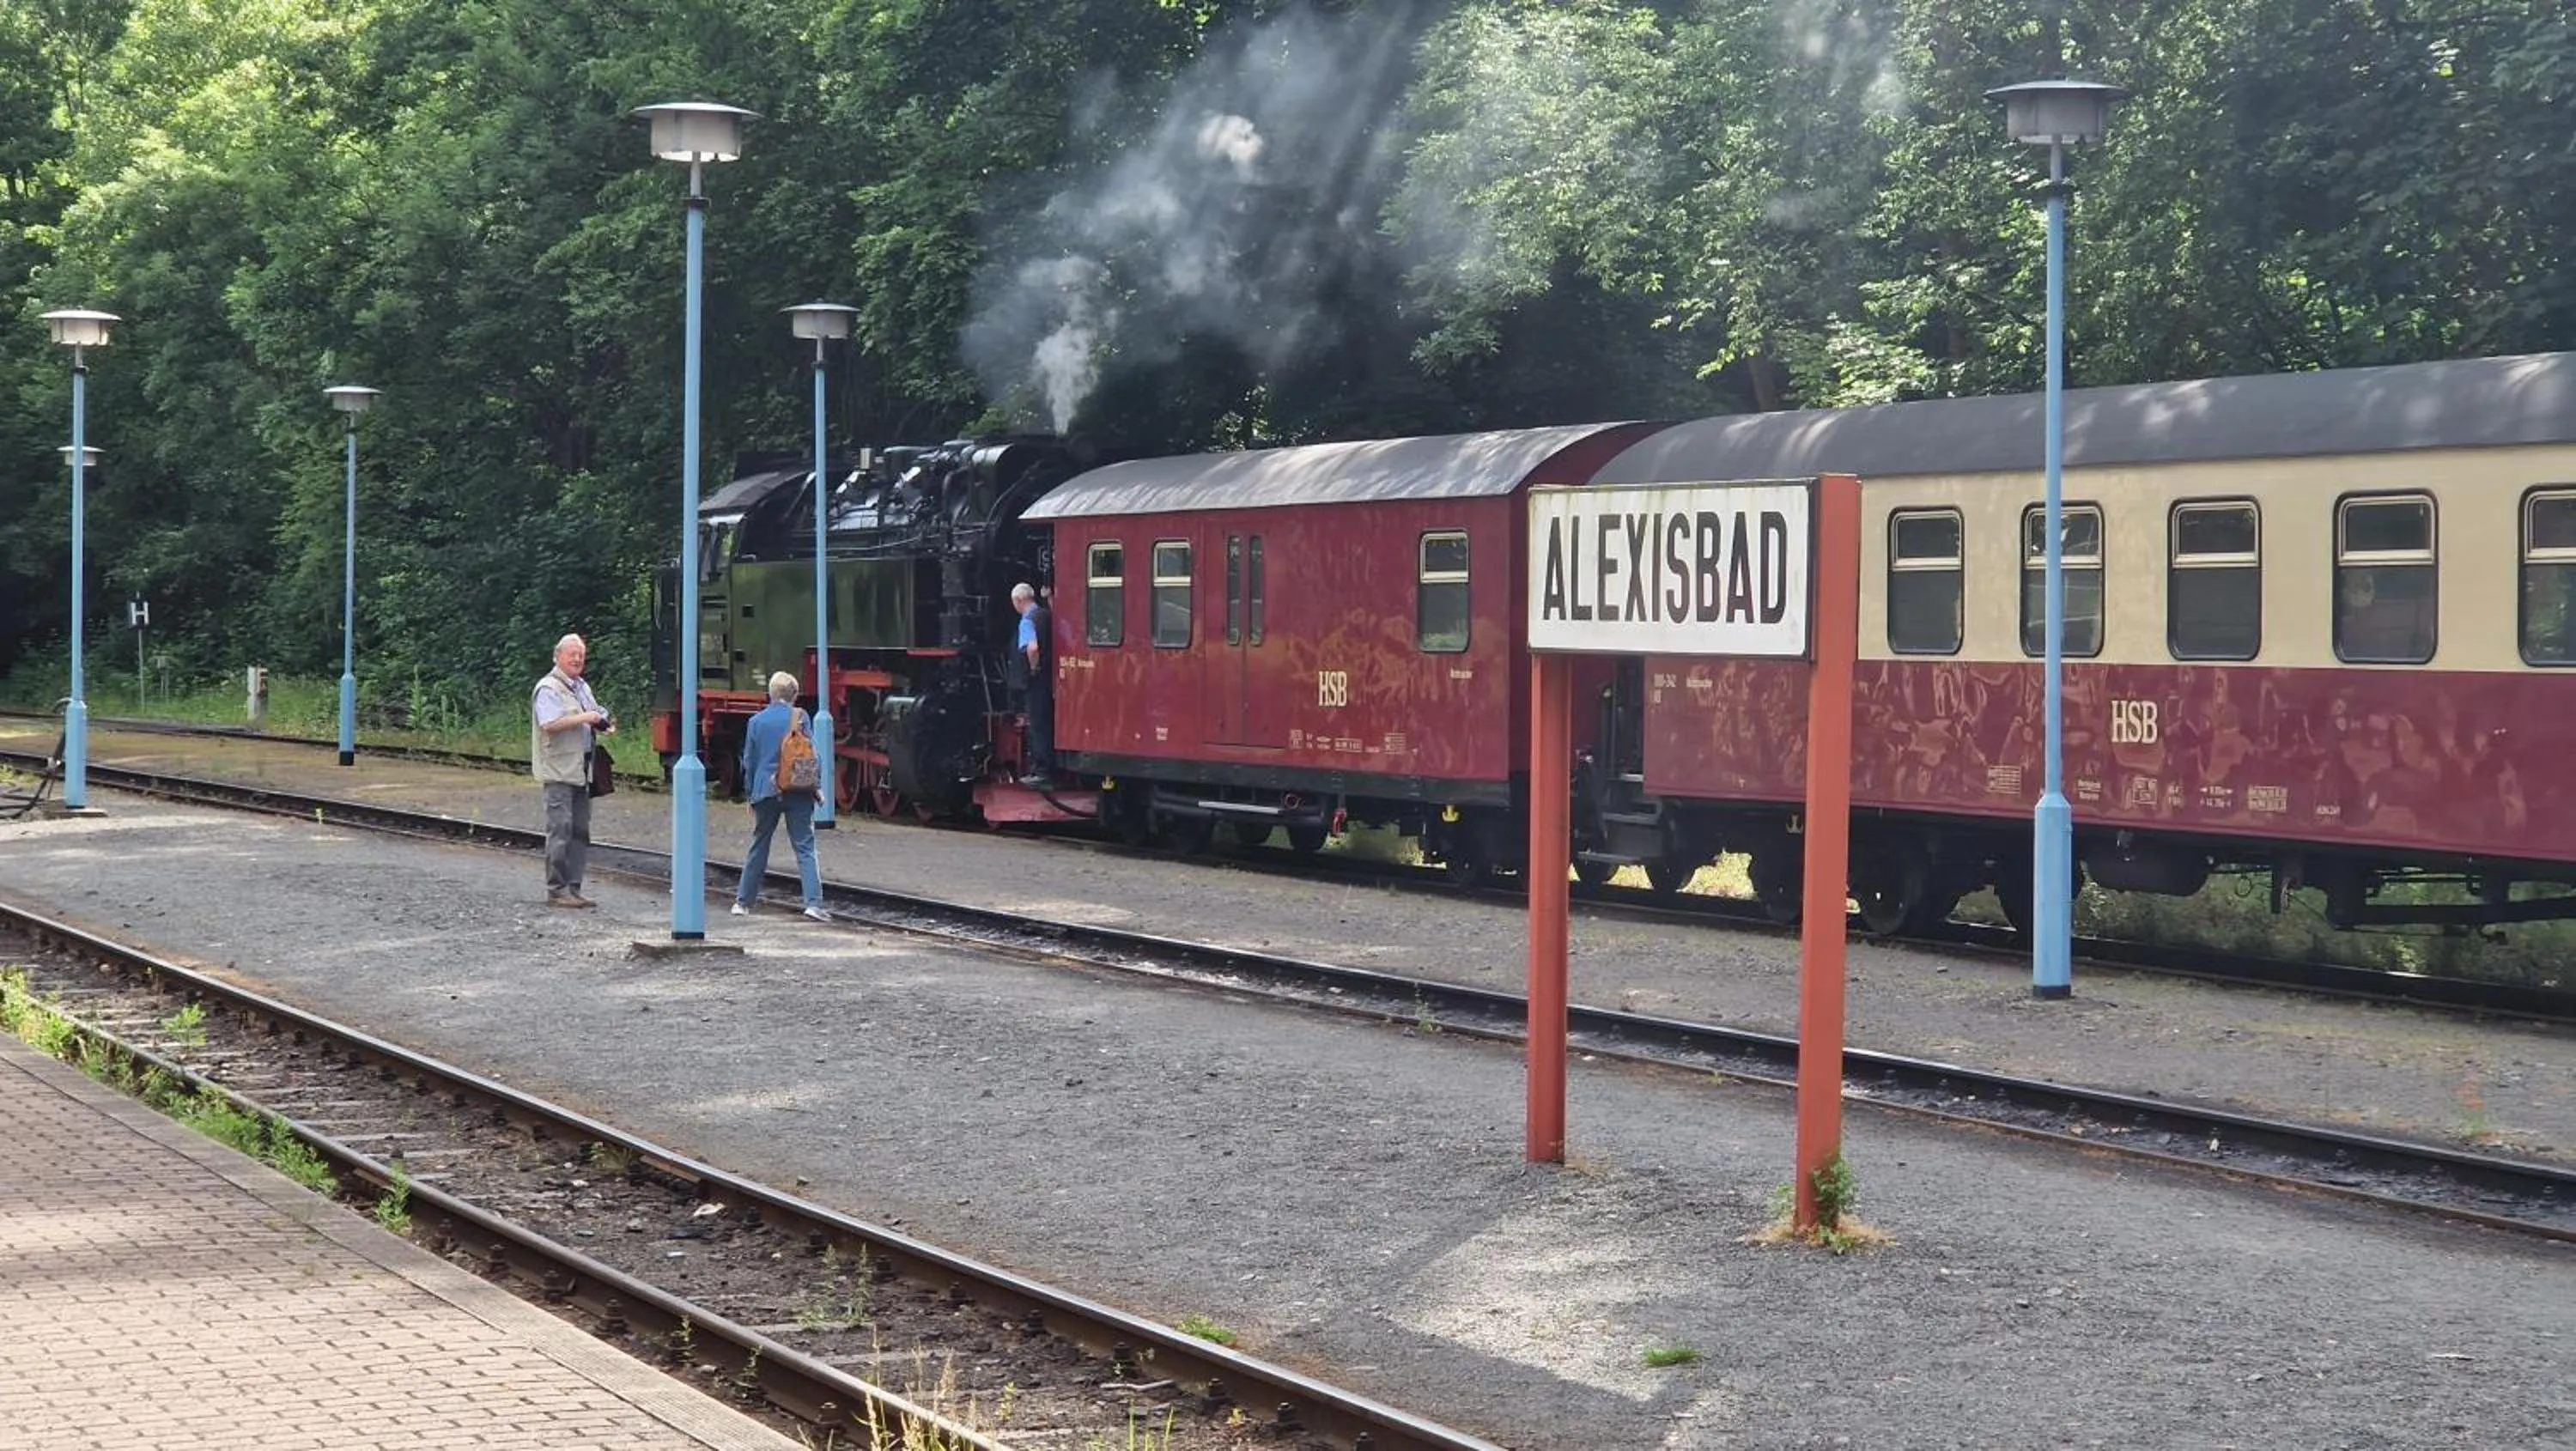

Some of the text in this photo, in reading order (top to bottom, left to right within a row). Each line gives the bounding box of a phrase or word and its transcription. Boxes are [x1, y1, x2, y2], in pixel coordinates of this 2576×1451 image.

[1543, 511, 1787, 624] ALEXISBAD
[131, 602, 149, 625] H
[1318, 671, 1347, 707] HSB
[2111, 700, 2158, 745] HSB
